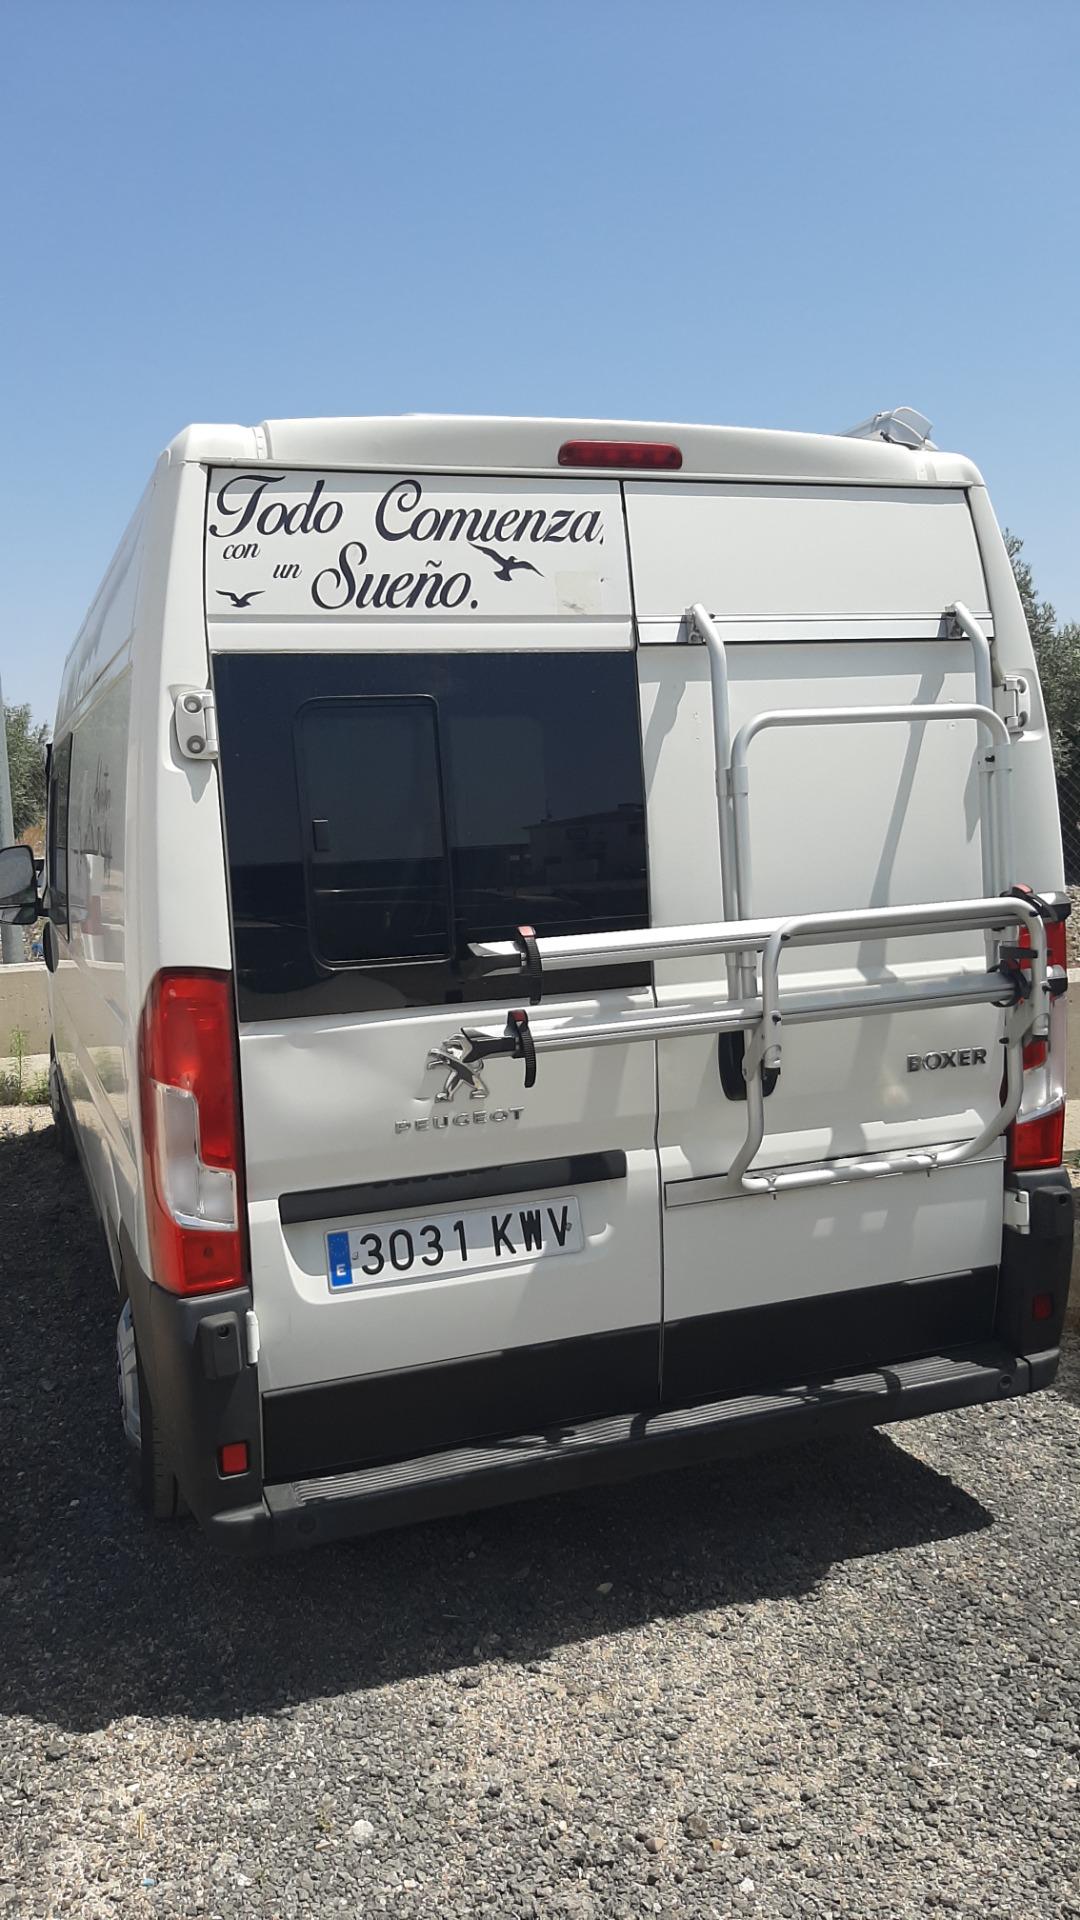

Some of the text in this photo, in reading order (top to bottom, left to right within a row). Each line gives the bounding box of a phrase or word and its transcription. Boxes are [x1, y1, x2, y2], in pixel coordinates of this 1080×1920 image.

[209, 474, 344, 537] Todo
[222, 541, 261, 560] con
[272, 541, 479, 610] un Sueño.
[906, 1046, 988, 1073] BOXER
[394, 1105, 526, 1134] PEUGEOT
[336, 1205, 569, 1277] E 3031 KWV
